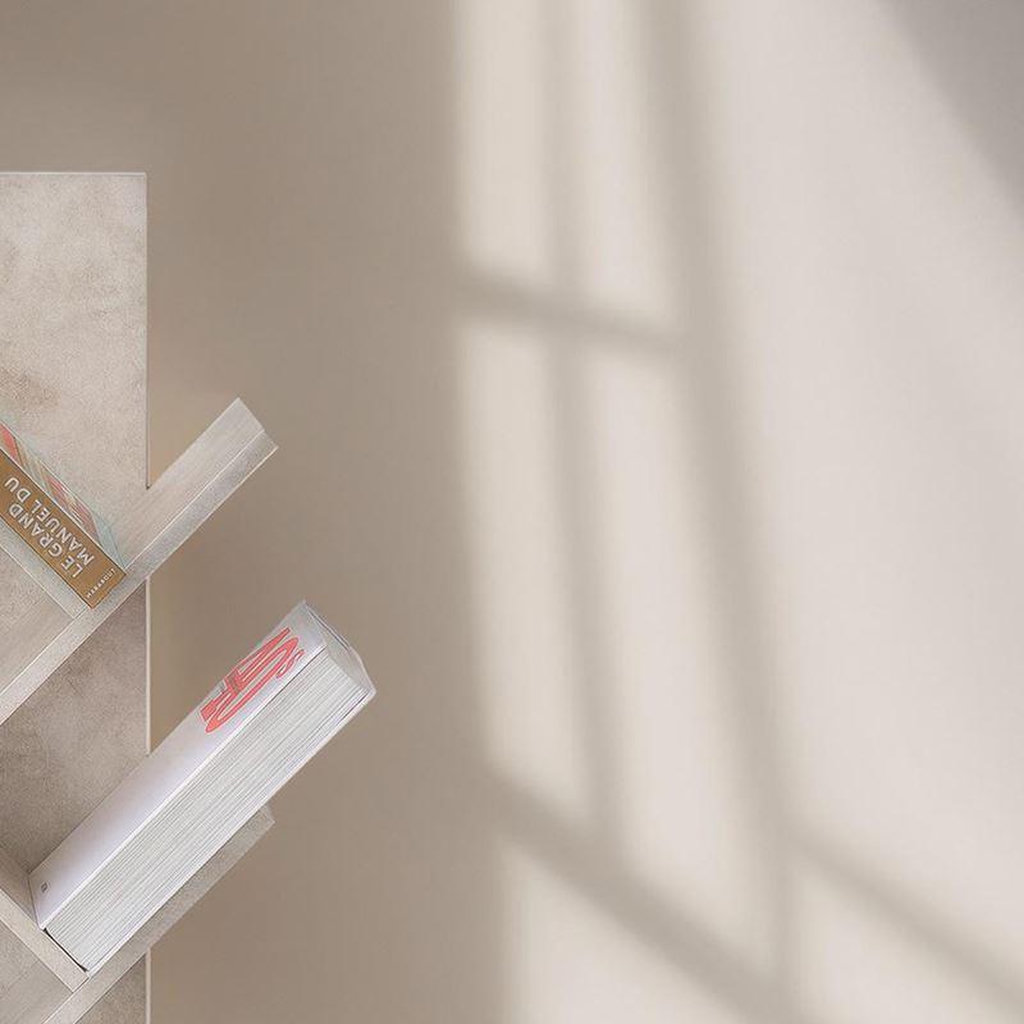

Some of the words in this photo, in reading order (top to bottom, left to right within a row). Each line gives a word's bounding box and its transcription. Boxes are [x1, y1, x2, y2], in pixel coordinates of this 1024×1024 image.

[4, 477, 31, 502] DU
[9, 503, 63, 557] GRAND
[31, 499, 94, 566] MANUEL
[61, 556, 83, 578] LE
